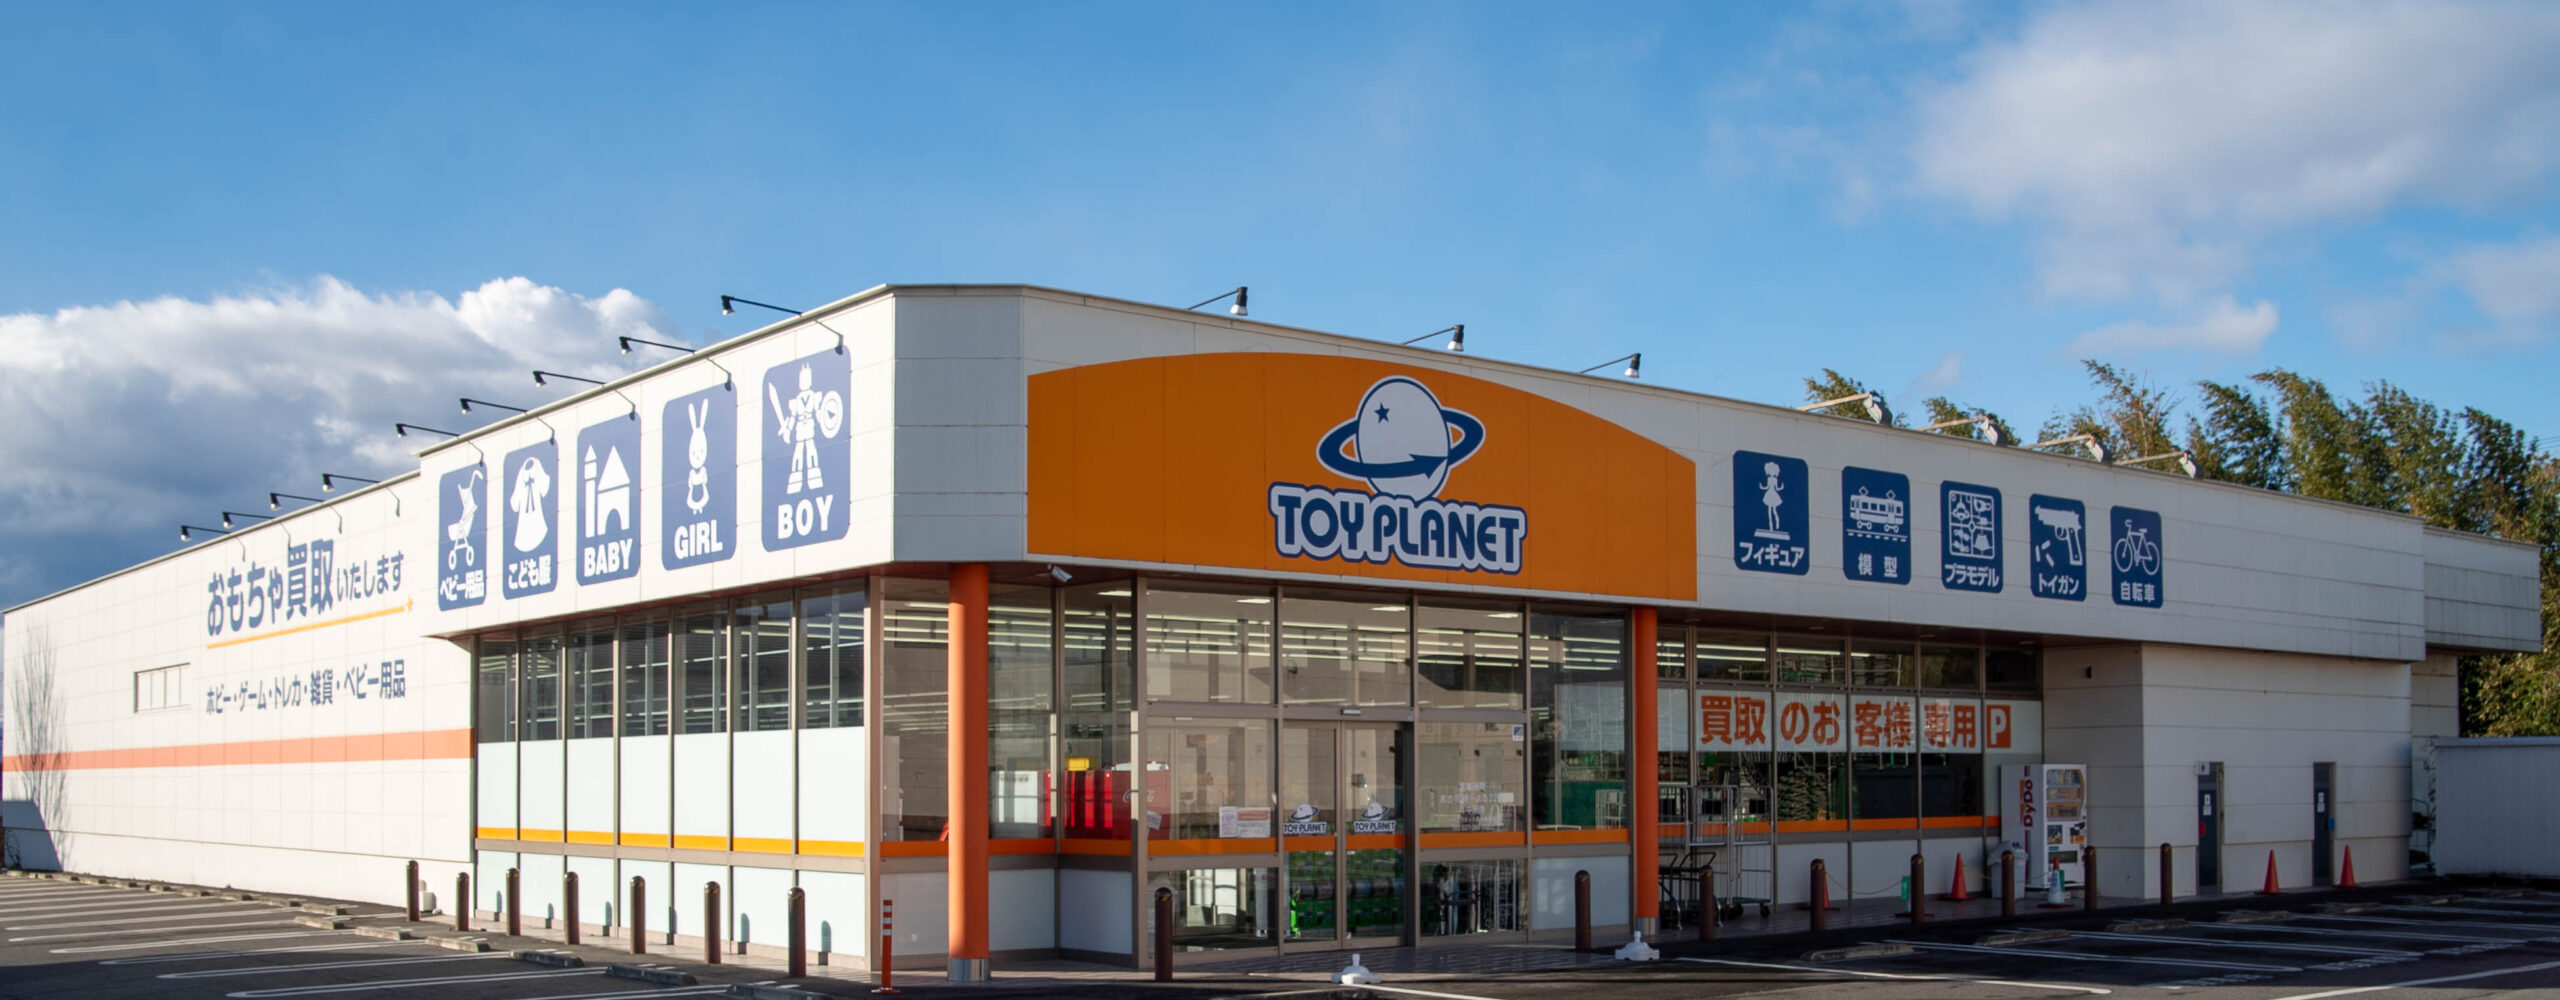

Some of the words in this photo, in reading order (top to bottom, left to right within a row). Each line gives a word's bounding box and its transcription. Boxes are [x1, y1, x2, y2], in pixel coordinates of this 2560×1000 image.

[777, 495, 833, 539] BOY
[1278, 494, 1364, 551] TOY
[1373, 504, 1519, 563] PLANET
[674, 519, 723, 559] GIRL
[1739, 541, 1804, 568] フィギュア
[508, 554, 551, 590] こども服
[583, 538, 633, 577] BABY
[1858, 553, 1898, 578] 模型
[207, 539, 404, 636] おもちゃ買取いたします
[440, 569, 485, 601] ベビー用品
[1945, 563, 1999, 587] プラモデル
[2038, 573, 2080, 595] トイガン
[2120, 580, 2156, 603] 自転車
[1701, 695, 1976, 749] 買取のお客様専用
[1988, 706, 2009, 747] P
[2023, 779, 2036, 828] DyDo
[1284, 823, 1299, 833] TOY
[1300, 823, 1326, 833] PLANET
[1355, 822, 1369, 831] TOY
[1370, 822, 1395, 832] PLANET
